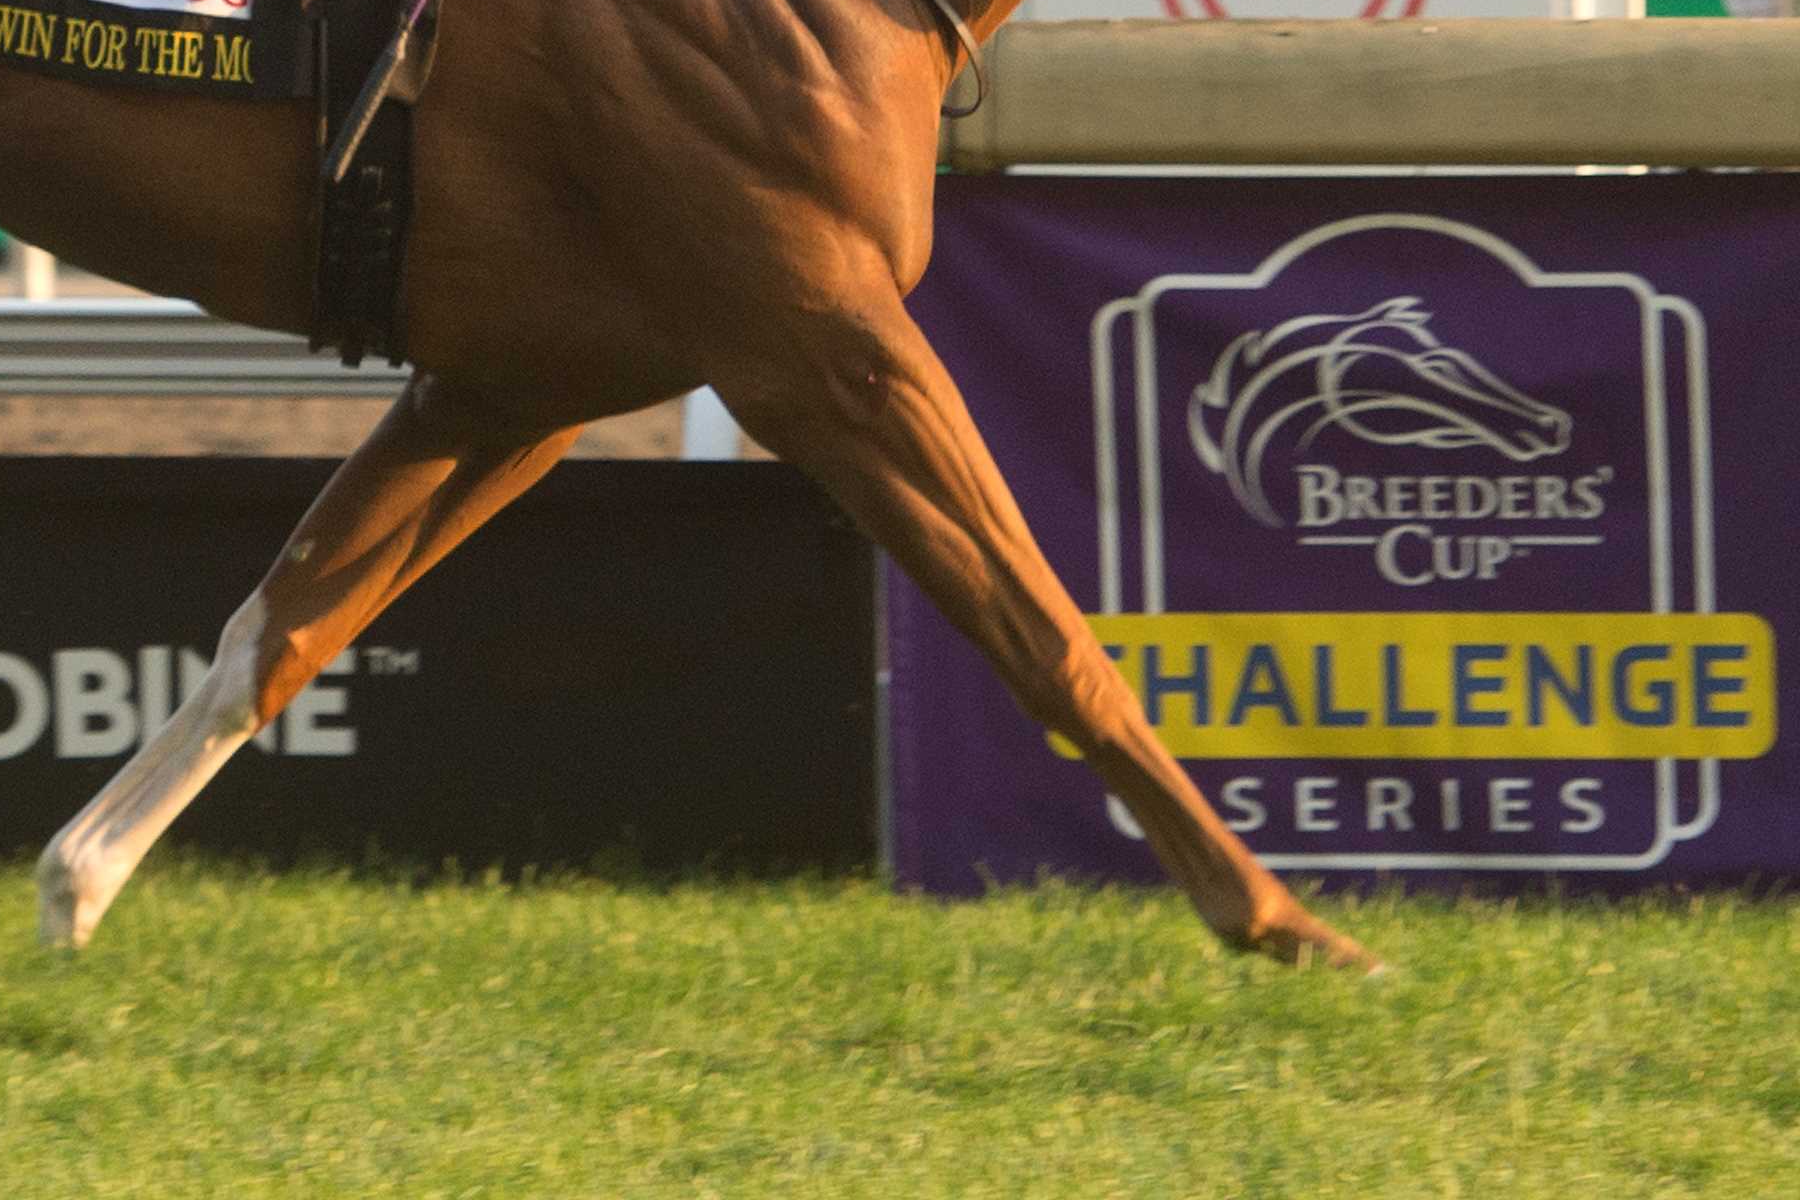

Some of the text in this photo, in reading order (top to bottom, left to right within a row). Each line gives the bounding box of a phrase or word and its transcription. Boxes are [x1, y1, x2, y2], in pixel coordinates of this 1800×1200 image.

[63, 17, 128, 71] FOR
[135, 28, 203, 79] THE
[1100, 642, 1753, 728] HALLENGE
[1218, 775, 1605, 834] SERIES
